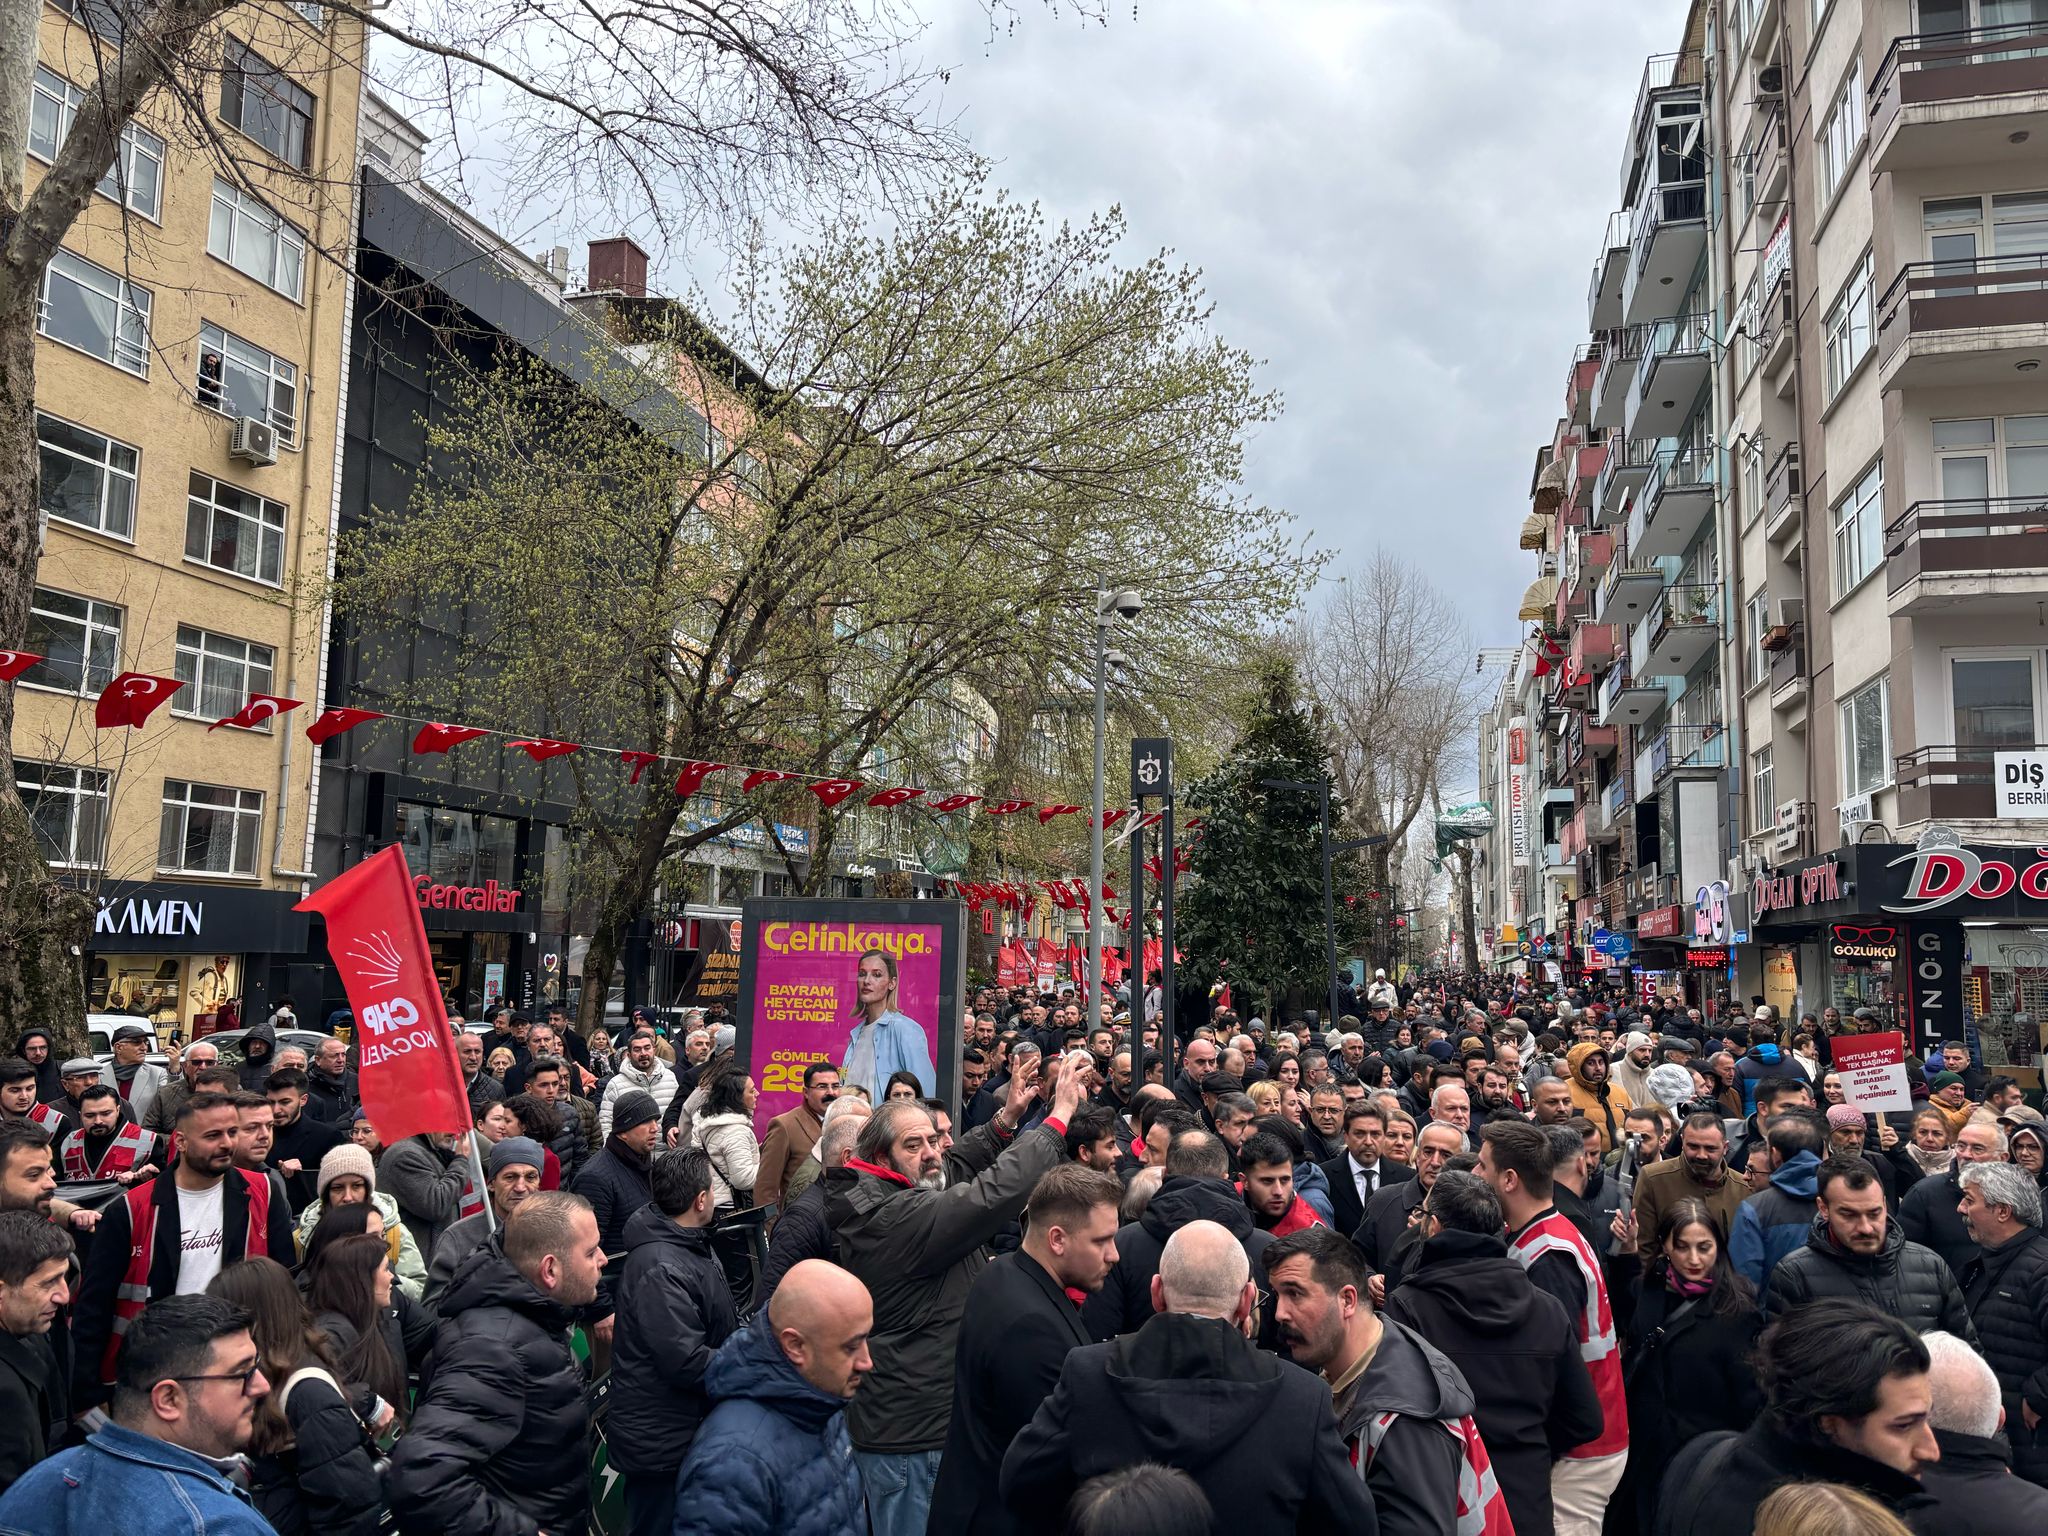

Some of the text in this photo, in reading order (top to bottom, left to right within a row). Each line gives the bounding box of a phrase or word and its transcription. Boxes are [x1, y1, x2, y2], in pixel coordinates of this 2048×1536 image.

[2005, 759, 2044, 789] DİŞ
[2008, 789, 2048, 805] BERRİ
[413, 874, 522, 912] Gencallar
[1750, 865, 1796, 918] DOĞAN
[1801, 853, 1840, 906] OPTİK
[95, 897, 203, 935] KAMEN
[1834, 943, 1897, 960] GÖZLÜKÇÜ
[769, 984, 834, 997] BAYRAM
[764, 997, 838, 1010] HEYECANI
[771, 1048, 830, 1063] GÖMLEK
[1839, 1048, 1896, 1063] KURTULUŞ YOK
[1846, 1061, 1860, 1069] TEK
[1853, 1075, 1891, 1085] BERABER
[1855, 1089, 1898, 1101] HİÇBİRİMİZ
